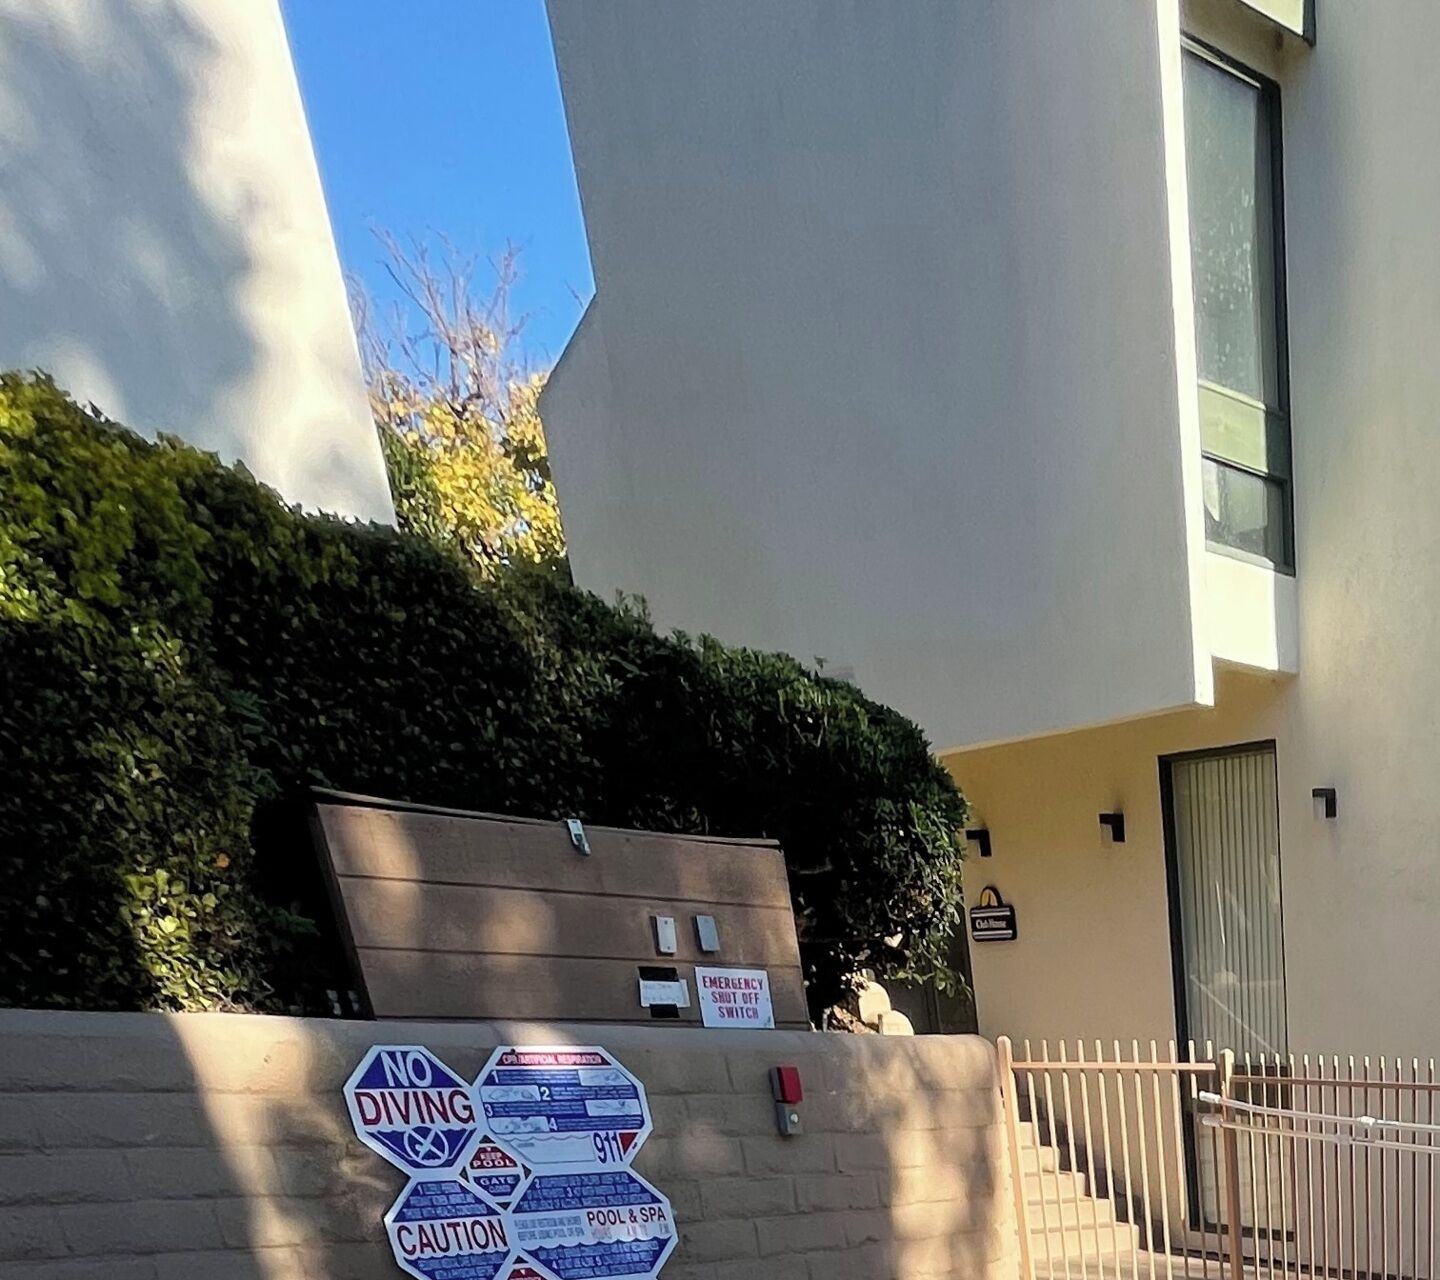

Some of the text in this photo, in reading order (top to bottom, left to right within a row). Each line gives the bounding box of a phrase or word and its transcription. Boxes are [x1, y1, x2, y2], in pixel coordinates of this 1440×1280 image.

[702, 975, 763, 991] EMERGENCY
[711, 991, 760, 1005] SHUT OFF
[718, 1006, 759, 1019] SWITCH
[381, 1051, 432, 1088] NO
[491, 1070, 499, 1083] 1
[540, 1086, 551, 1100] 2
[354, 1089, 476, 1126] DIVING
[484, 1103, 493, 1117] 3
[550, 1117, 558, 1131] 4
[593, 1131, 623, 1164] 911
[473, 1159, 514, 1168] POOL
[480, 1176, 517, 1186] GATE
[534, 1178, 541, 1189] 2
[566, 1187, 573, 1198] 3
[586, 1206, 667, 1227] POOL & SPA
[397, 1218, 508, 1255] CAUTION
